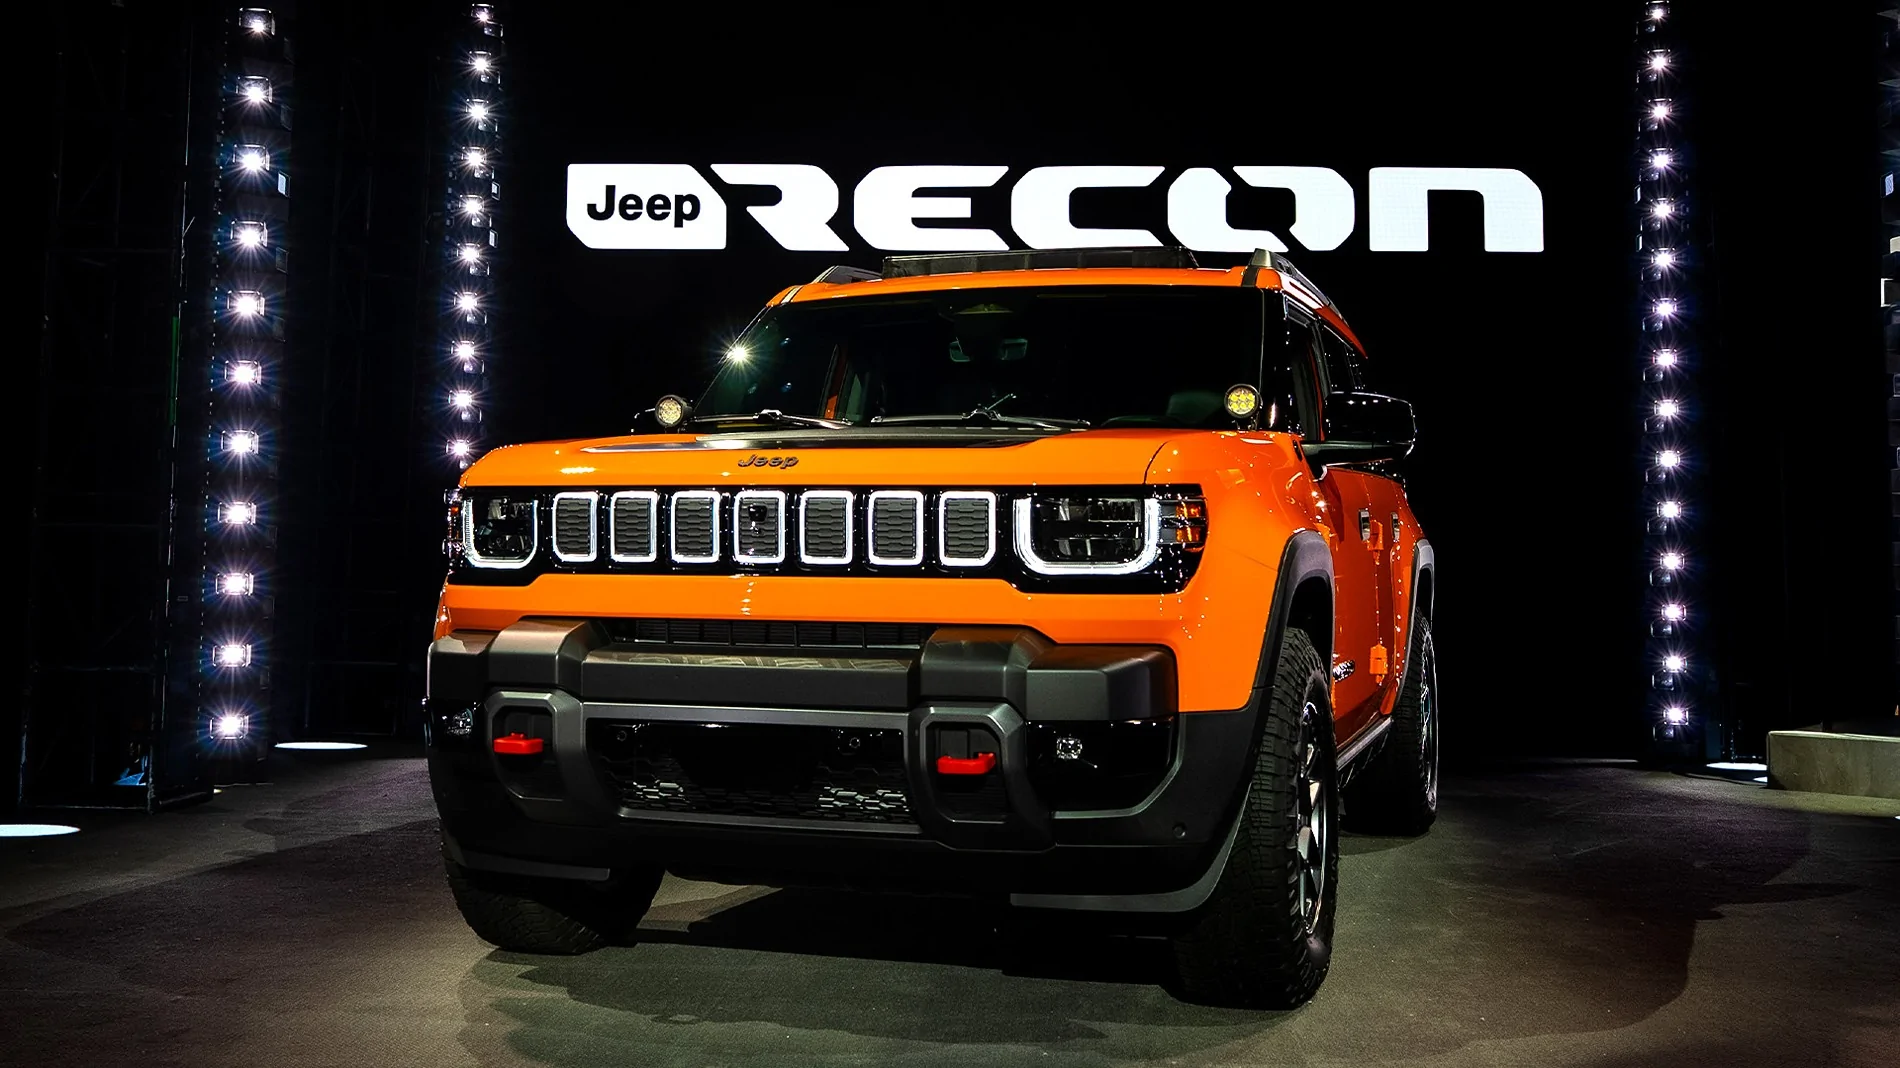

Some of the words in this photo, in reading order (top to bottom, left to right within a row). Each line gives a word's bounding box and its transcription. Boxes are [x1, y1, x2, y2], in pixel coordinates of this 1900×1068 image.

[586, 184, 701, 228] Jeep
[711, 164, 1545, 252] RECON
[738, 453, 799, 469] Jeep
